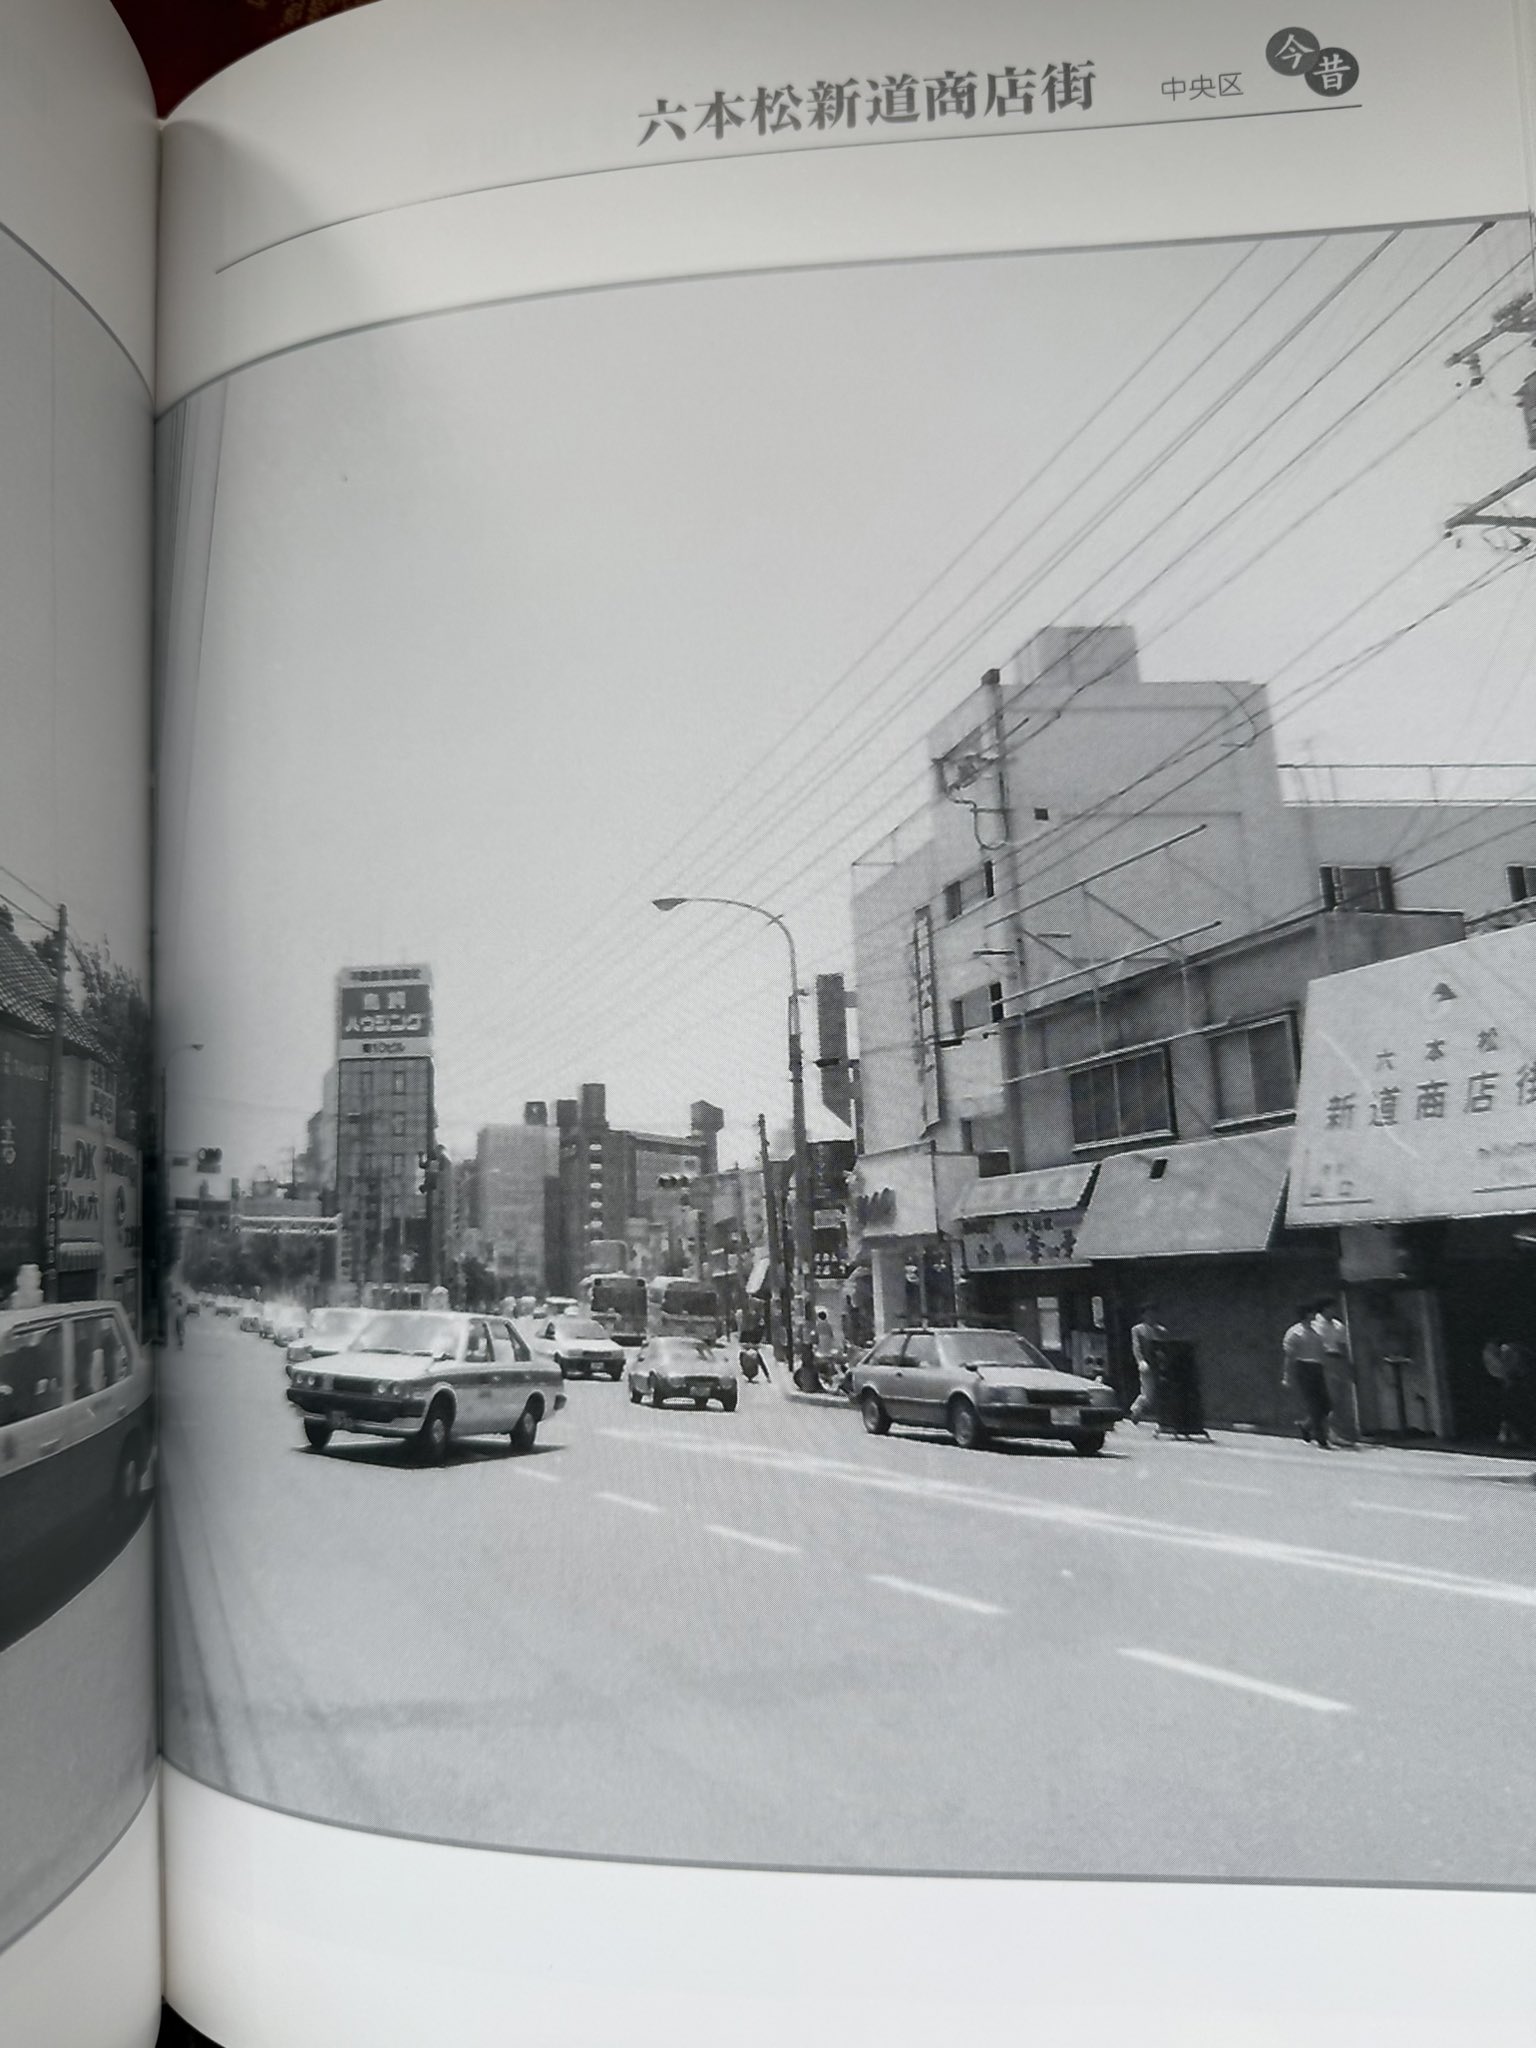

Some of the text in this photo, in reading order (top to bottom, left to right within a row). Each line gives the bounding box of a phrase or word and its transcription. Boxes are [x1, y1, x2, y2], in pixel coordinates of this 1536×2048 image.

[637, 59, 1097, 147] 六本松新道商店街
[1161, 72, 1244, 101] 中央区
[1375, 1027, 1498, 1071] 六本松
